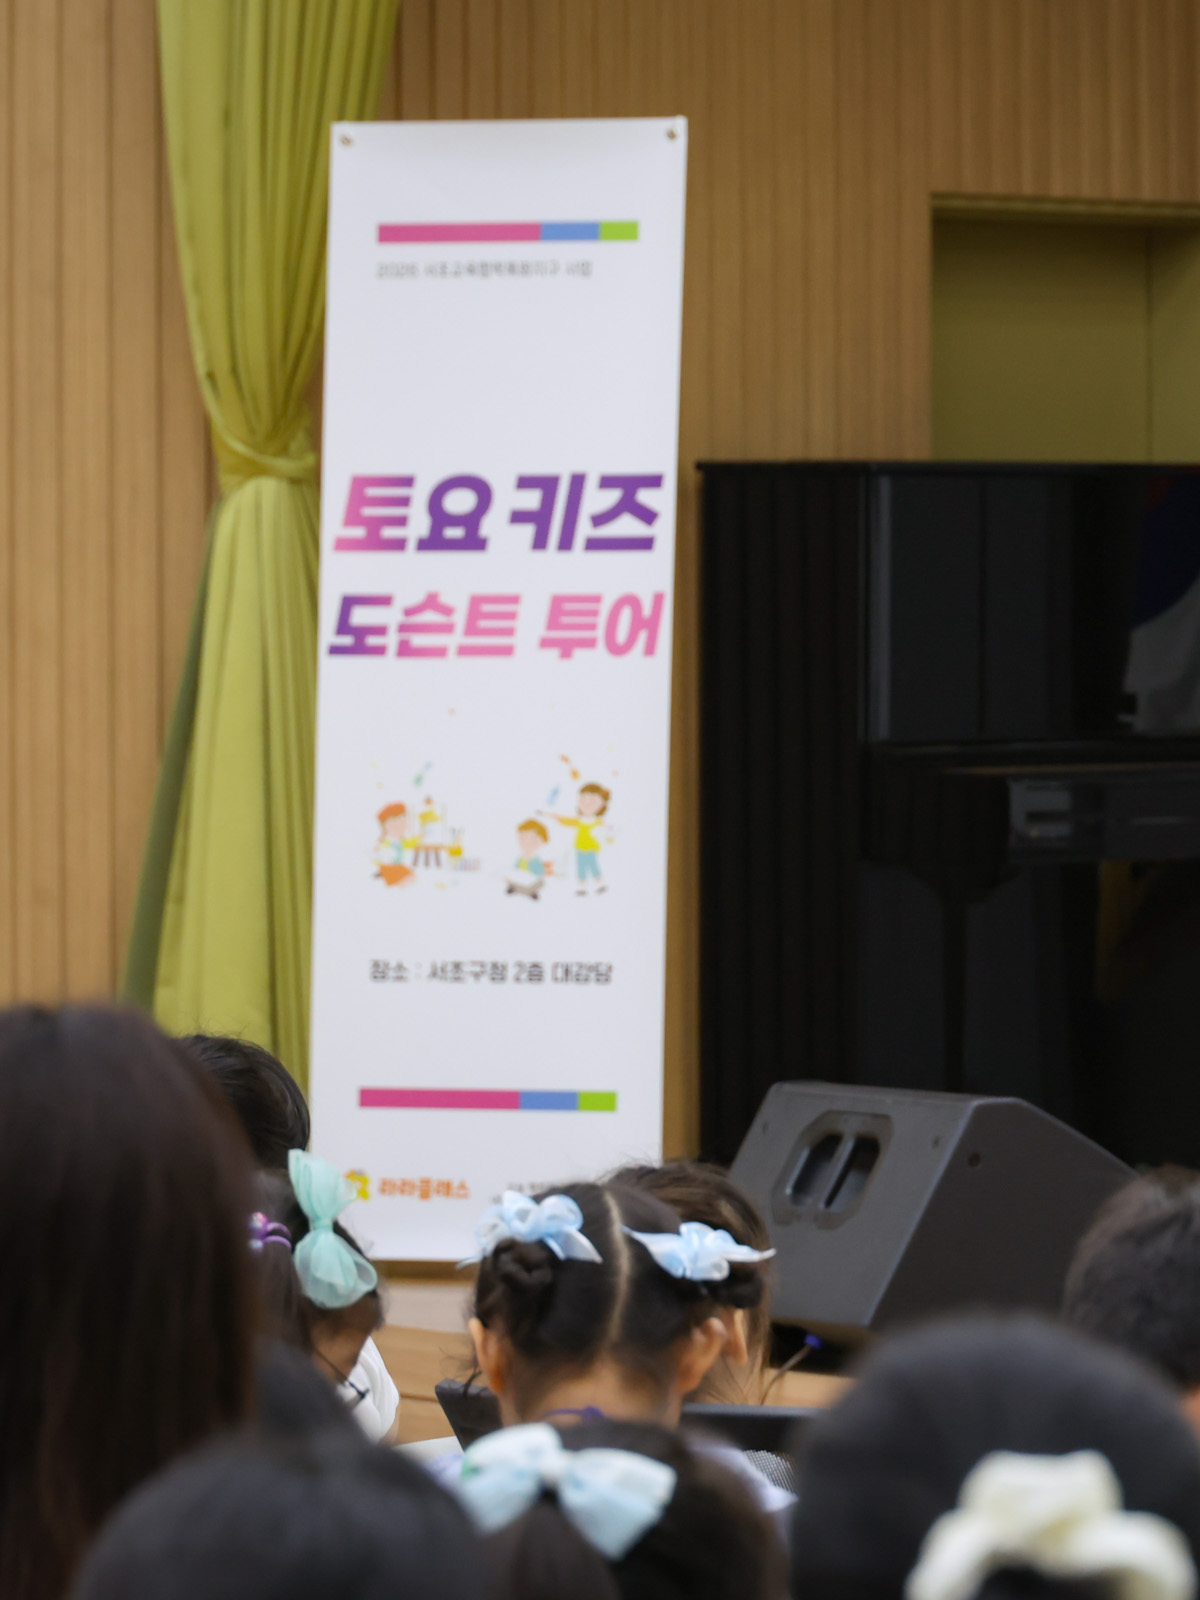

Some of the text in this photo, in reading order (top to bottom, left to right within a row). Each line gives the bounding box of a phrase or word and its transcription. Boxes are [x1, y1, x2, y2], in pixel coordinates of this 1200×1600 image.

[334, 472, 665, 552] 토요 키즈
[327, 592, 665, 660] 도슨트 투어
[370, 959, 409, 983] 장소
[427, 960, 508, 984] 서초구청
[513, 961, 545, 984] 2층
[551, 961, 613, 985] 대강당
[378, 1177, 470, 1201] 라라클래스
